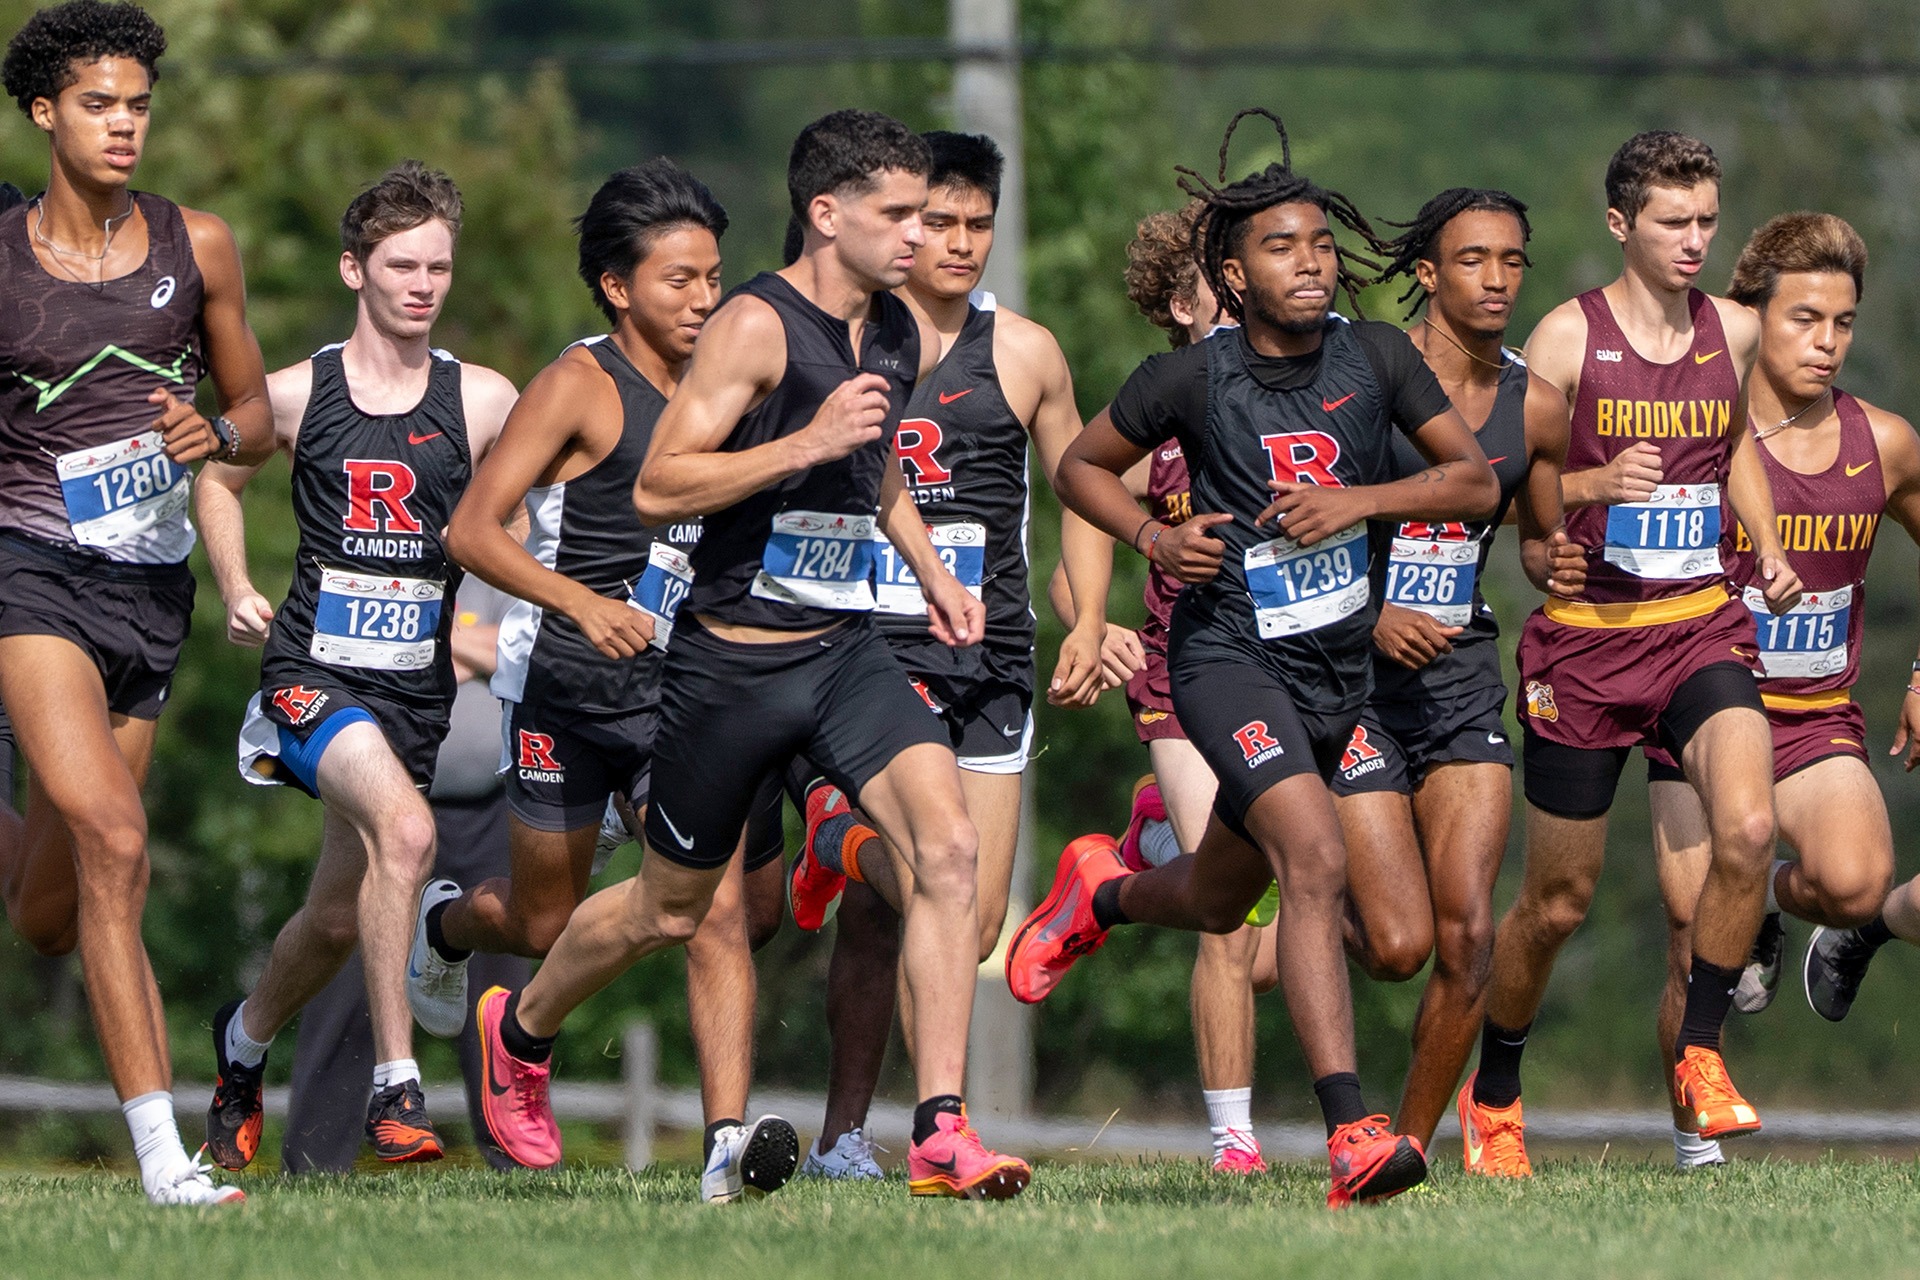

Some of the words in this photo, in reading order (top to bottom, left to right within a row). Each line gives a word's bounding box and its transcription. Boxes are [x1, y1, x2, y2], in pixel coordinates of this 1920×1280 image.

[1597, 398, 1730, 438] BROOKLYN
[894, 417, 951, 487] R
[1260, 430, 1351, 503] R
[93, 453, 172, 512] 1280
[342, 458, 423, 534] R
[341, 536, 423, 558] CAMDEN
[1637, 509, 1704, 547] 1118
[1736, 513, 1878, 551] BOOKLYN
[792, 538, 855, 579] 1284
[881, 545, 957, 584] 123
[1277, 547, 1353, 602] 1239
[1386, 563, 1457, 603] 1236
[346, 599, 421, 640] 1238
[1766, 613, 1835, 650] 1115
[518, 728, 561, 771] R
[1232, 720, 1279, 761] R
[1248, 745, 1284, 769] CAMDEN
[519, 768, 565, 783] CAMDEN
[1344, 757, 1386, 781] CAMDEN
